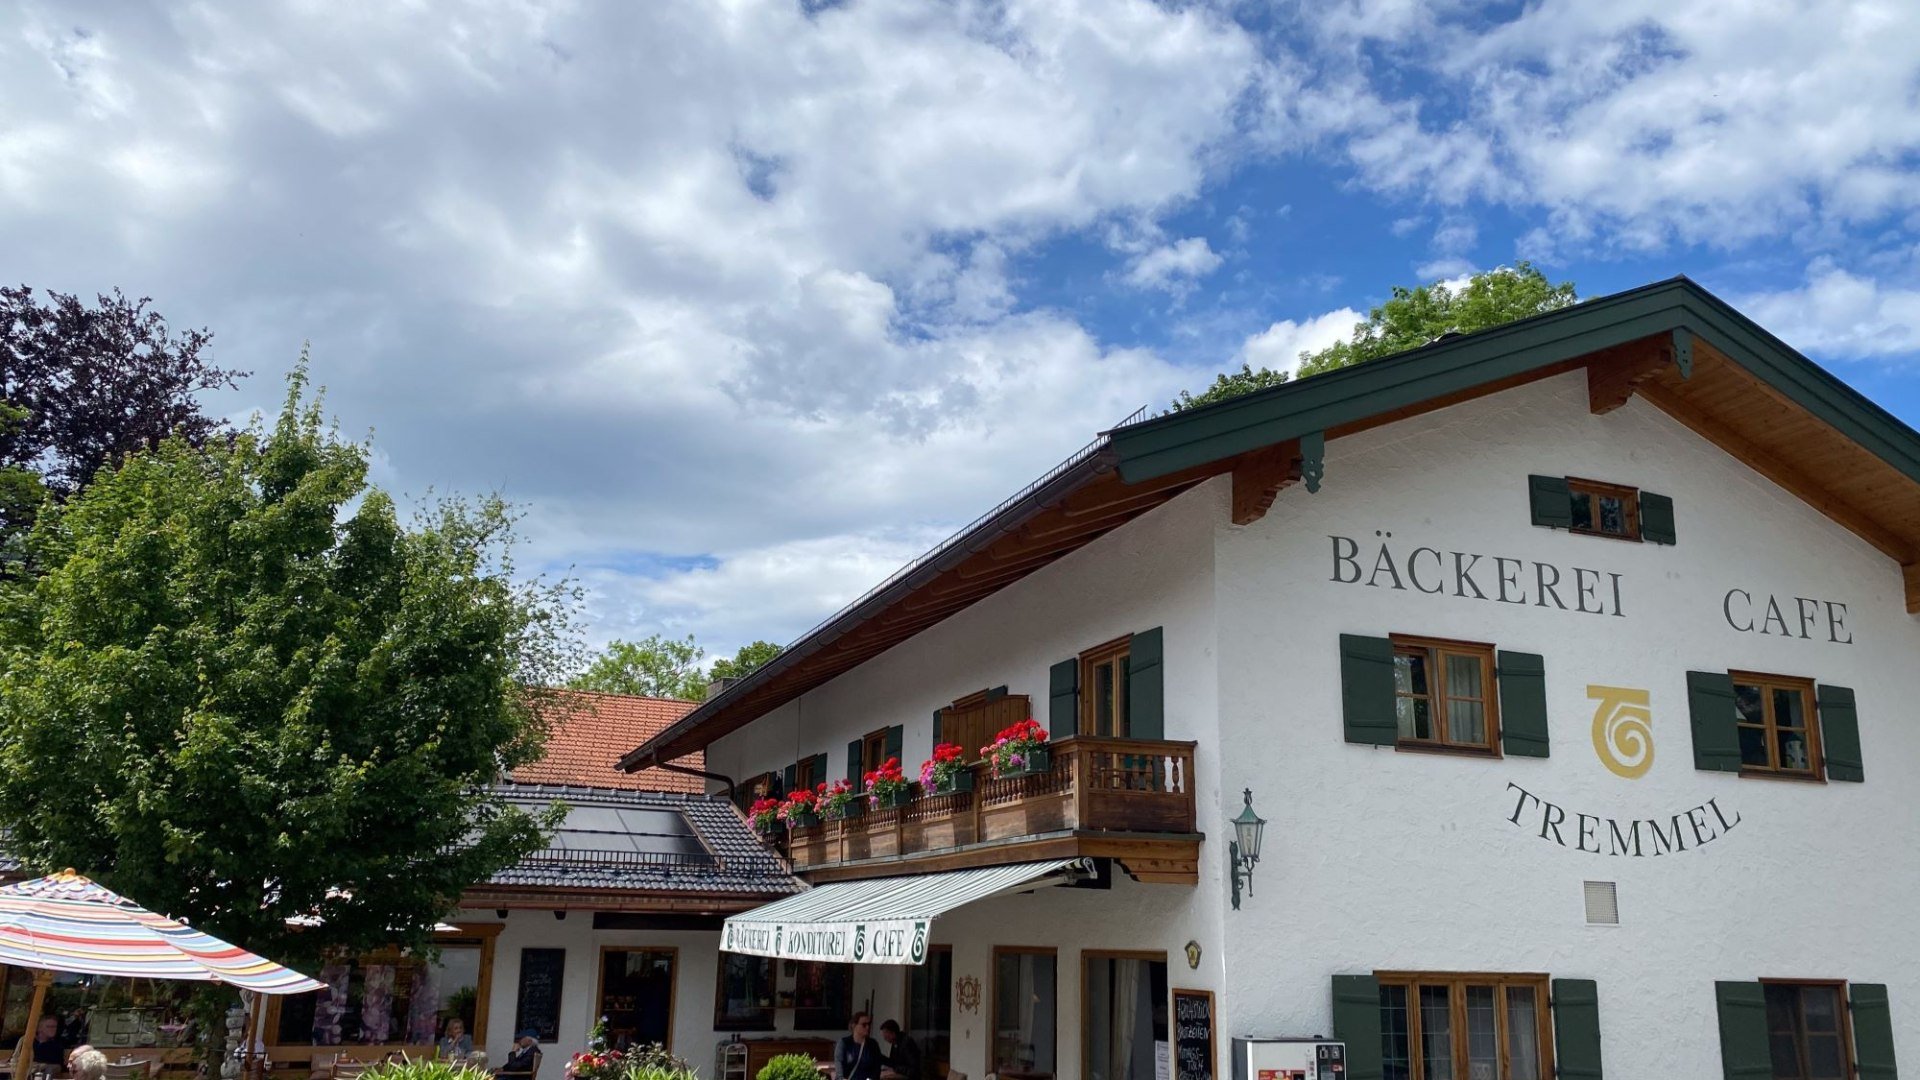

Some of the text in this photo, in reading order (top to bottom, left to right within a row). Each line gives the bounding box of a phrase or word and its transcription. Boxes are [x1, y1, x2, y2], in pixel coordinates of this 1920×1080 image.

[1327, 530, 1626, 618] BÄCKEREI
[1723, 588, 1853, 645] CAFE
[1506, 782, 1741, 858] TREMMEL
[788, 930, 846, 956] KONDITOREI
[873, 929, 904, 957] CAFE
